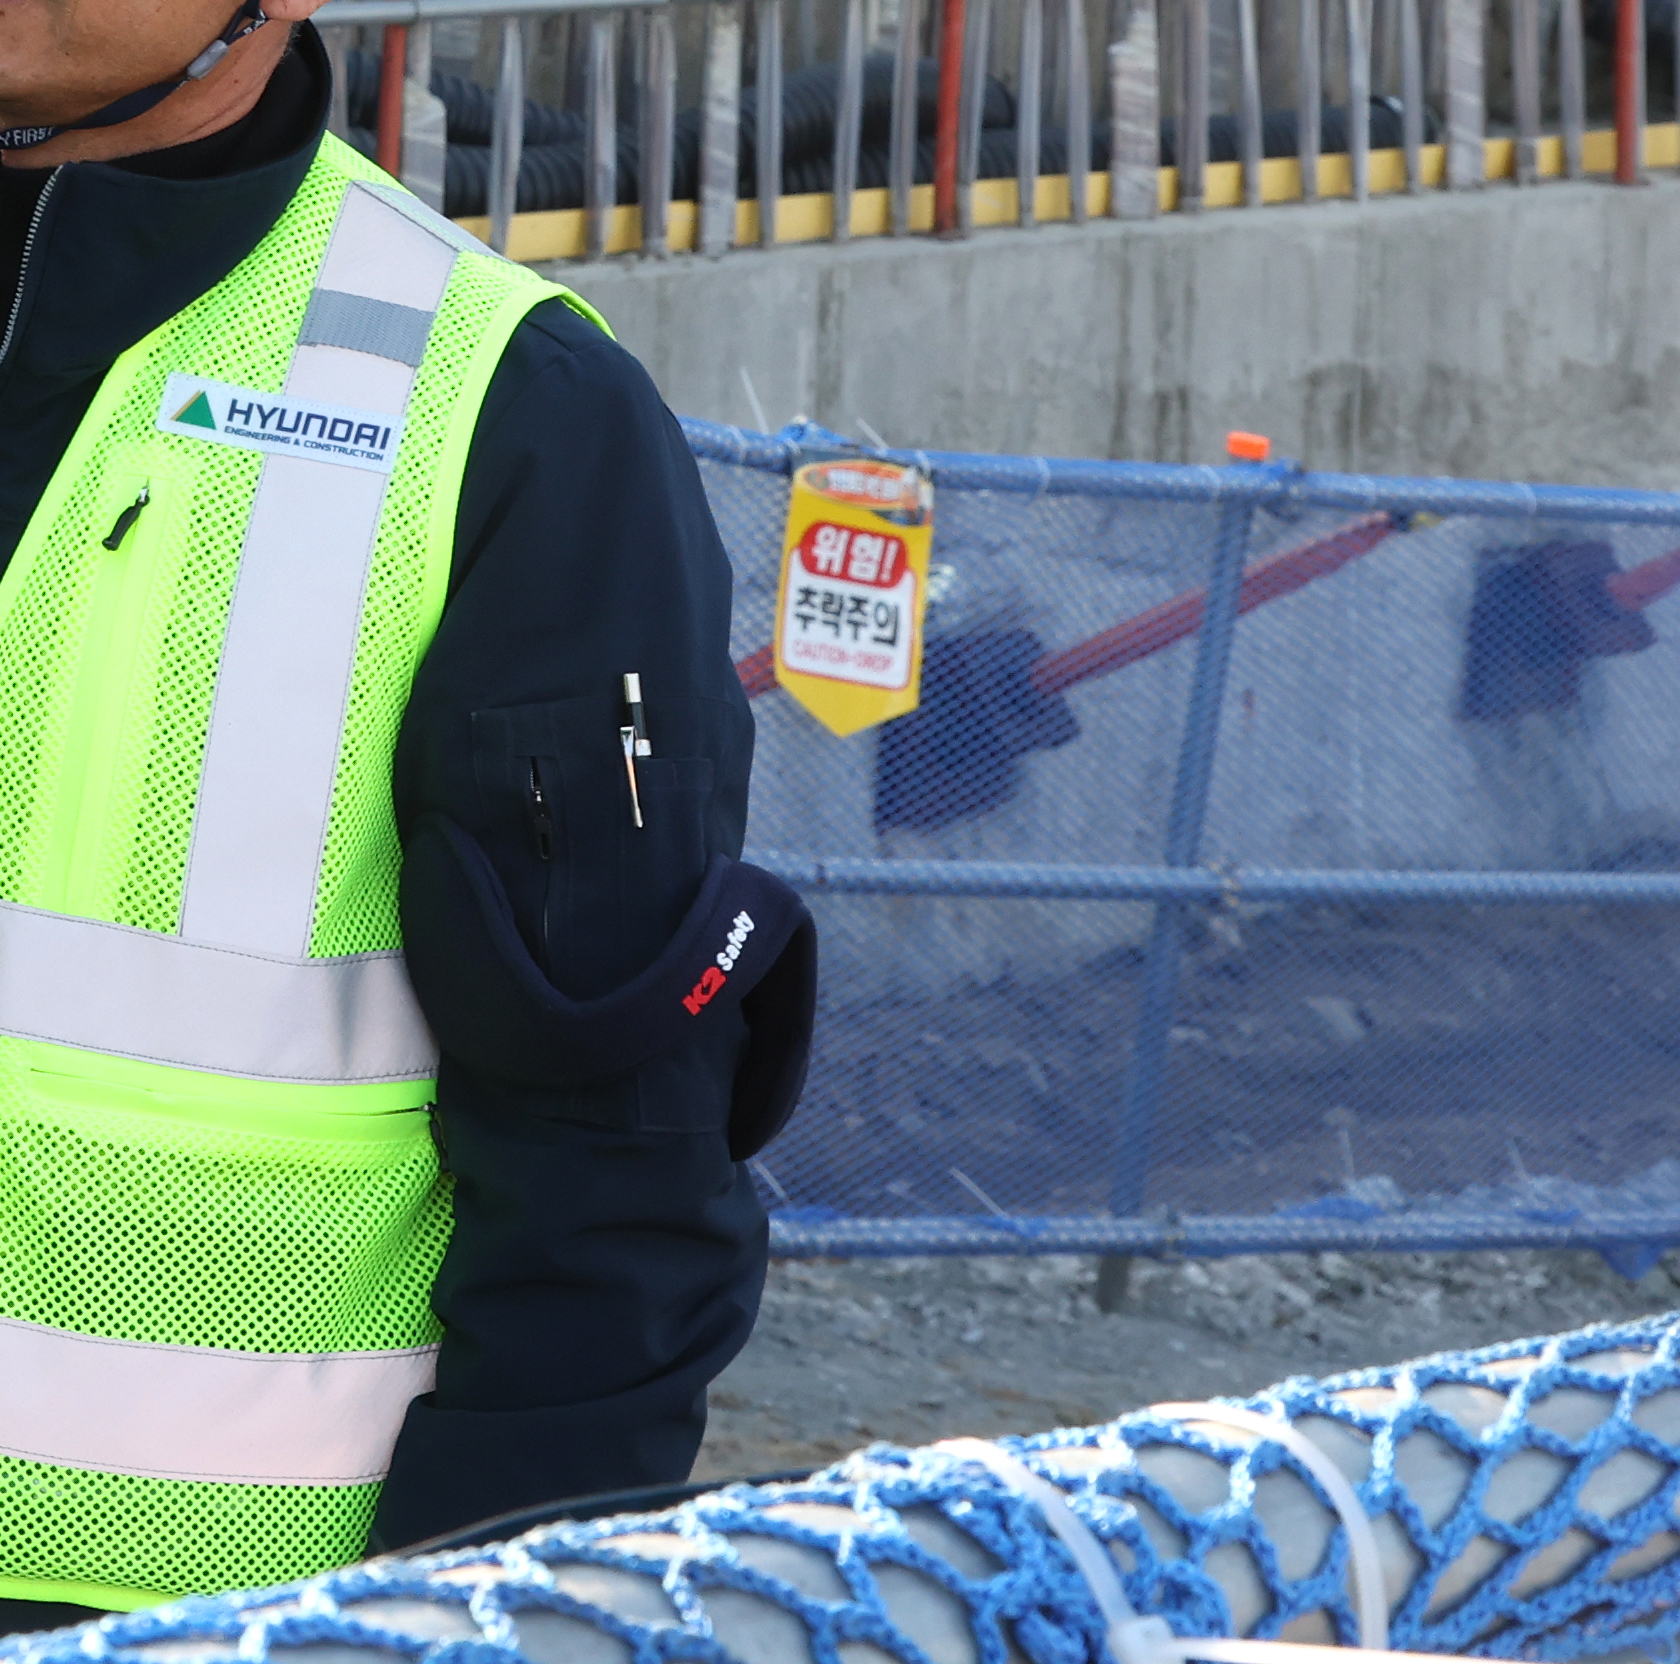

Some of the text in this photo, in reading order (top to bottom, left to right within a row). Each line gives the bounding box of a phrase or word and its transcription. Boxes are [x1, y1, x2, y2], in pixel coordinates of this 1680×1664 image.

[224, 425, 384, 462] ENGINEERING & CONSTRUCTION
[226, 398, 392, 451] HYUNDAI
[812, 524, 900, 584] 위험!
[794, 586, 900, 649] 추락주의
[681, 910, 755, 1016] K2 Safety
